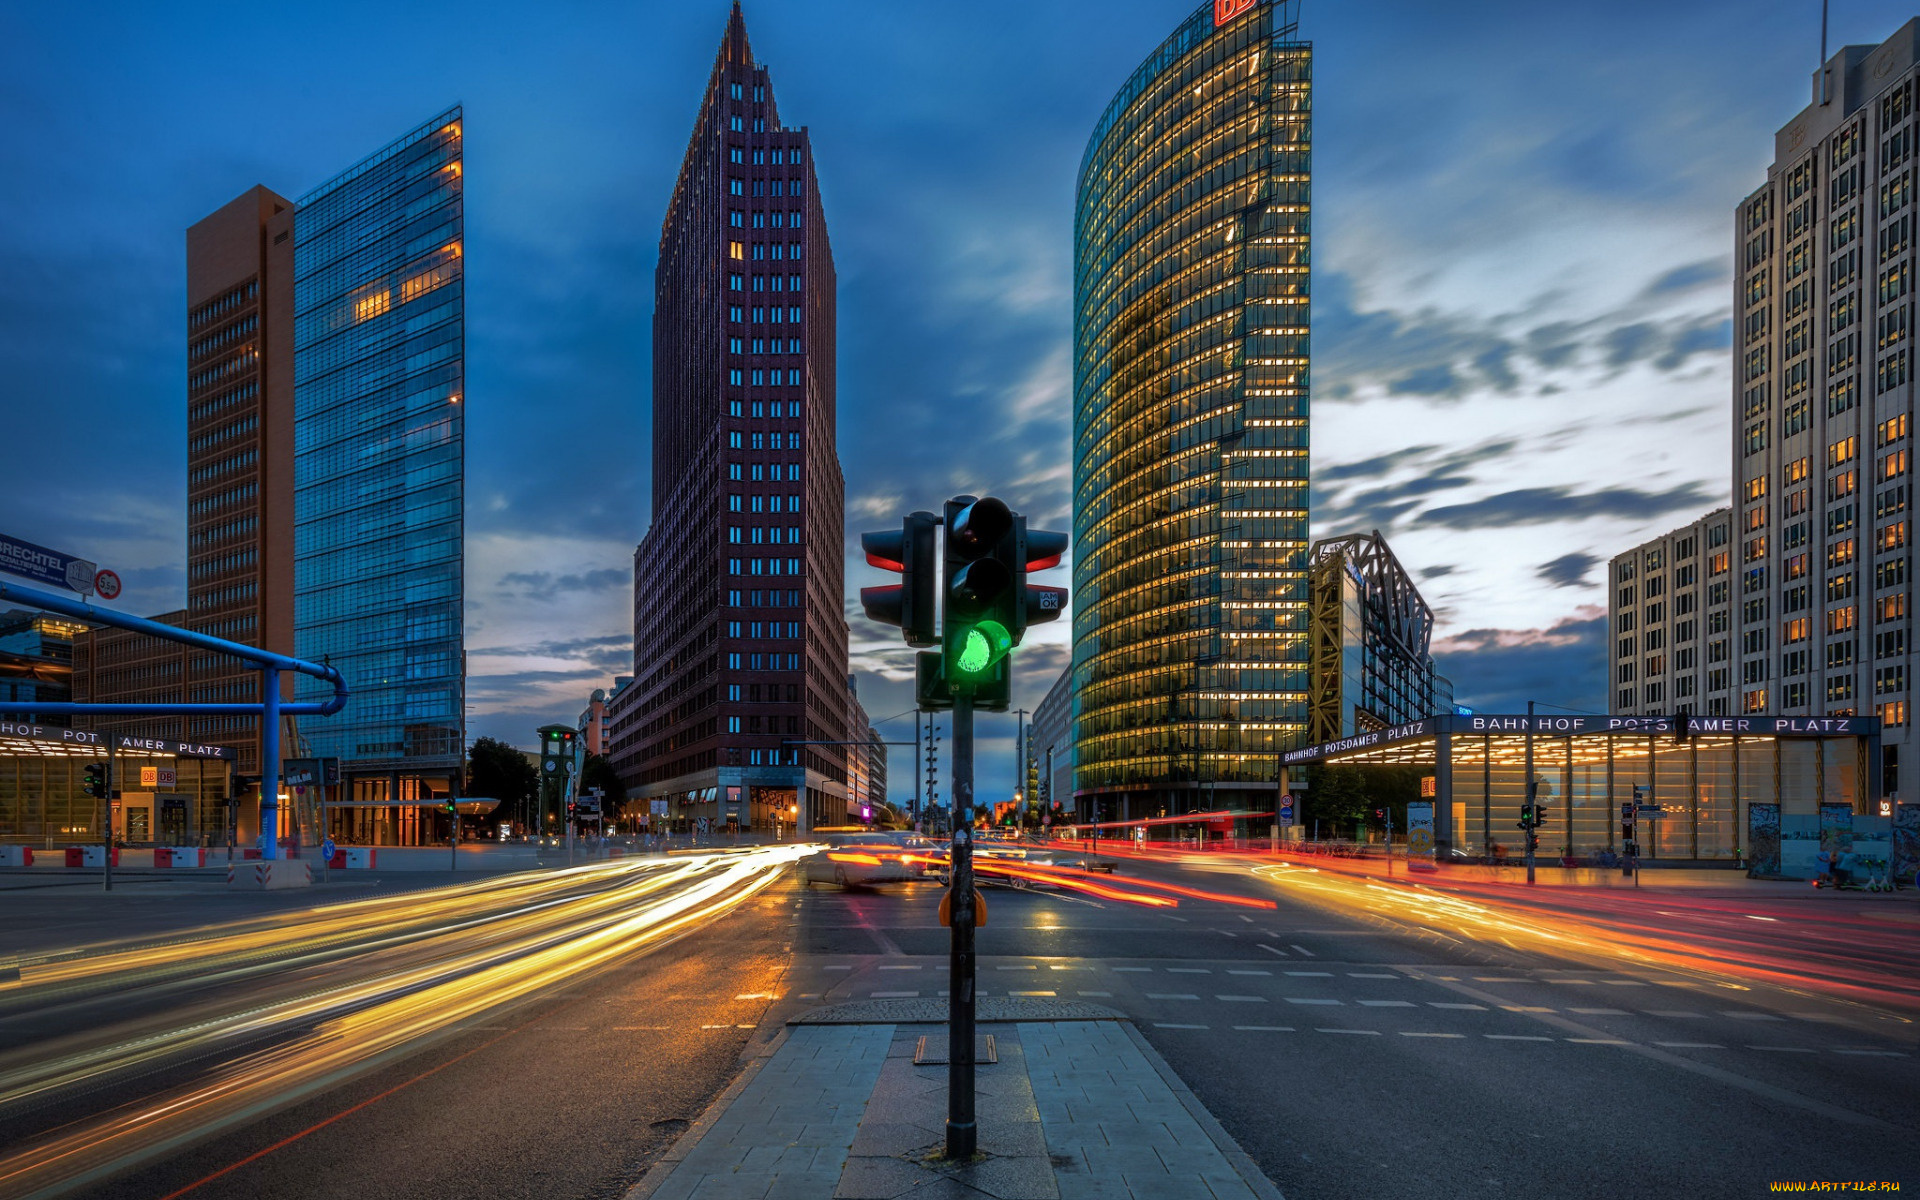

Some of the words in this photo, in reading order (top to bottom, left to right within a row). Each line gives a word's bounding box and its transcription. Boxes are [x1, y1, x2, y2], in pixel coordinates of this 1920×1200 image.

[1043, 600, 1057, 608] OK
[1473, 718, 1585, 730] BAHNHOF
[1610, 718, 1750, 731] POTSAMER
[1776, 719, 1850, 731] PLATZ
[2, 723, 43, 736] HOF
[64, 731, 164, 750] POTAMER
[179, 743, 222, 757] PLATZ
[1285, 747, 1319, 762] BAHNHOF
[1325, 734, 1378, 754] POTSDAMER
[1388, 723, 1424, 740] PLATZ
[144, 772, 155, 781] DB
[160, 772, 173, 781] DB
